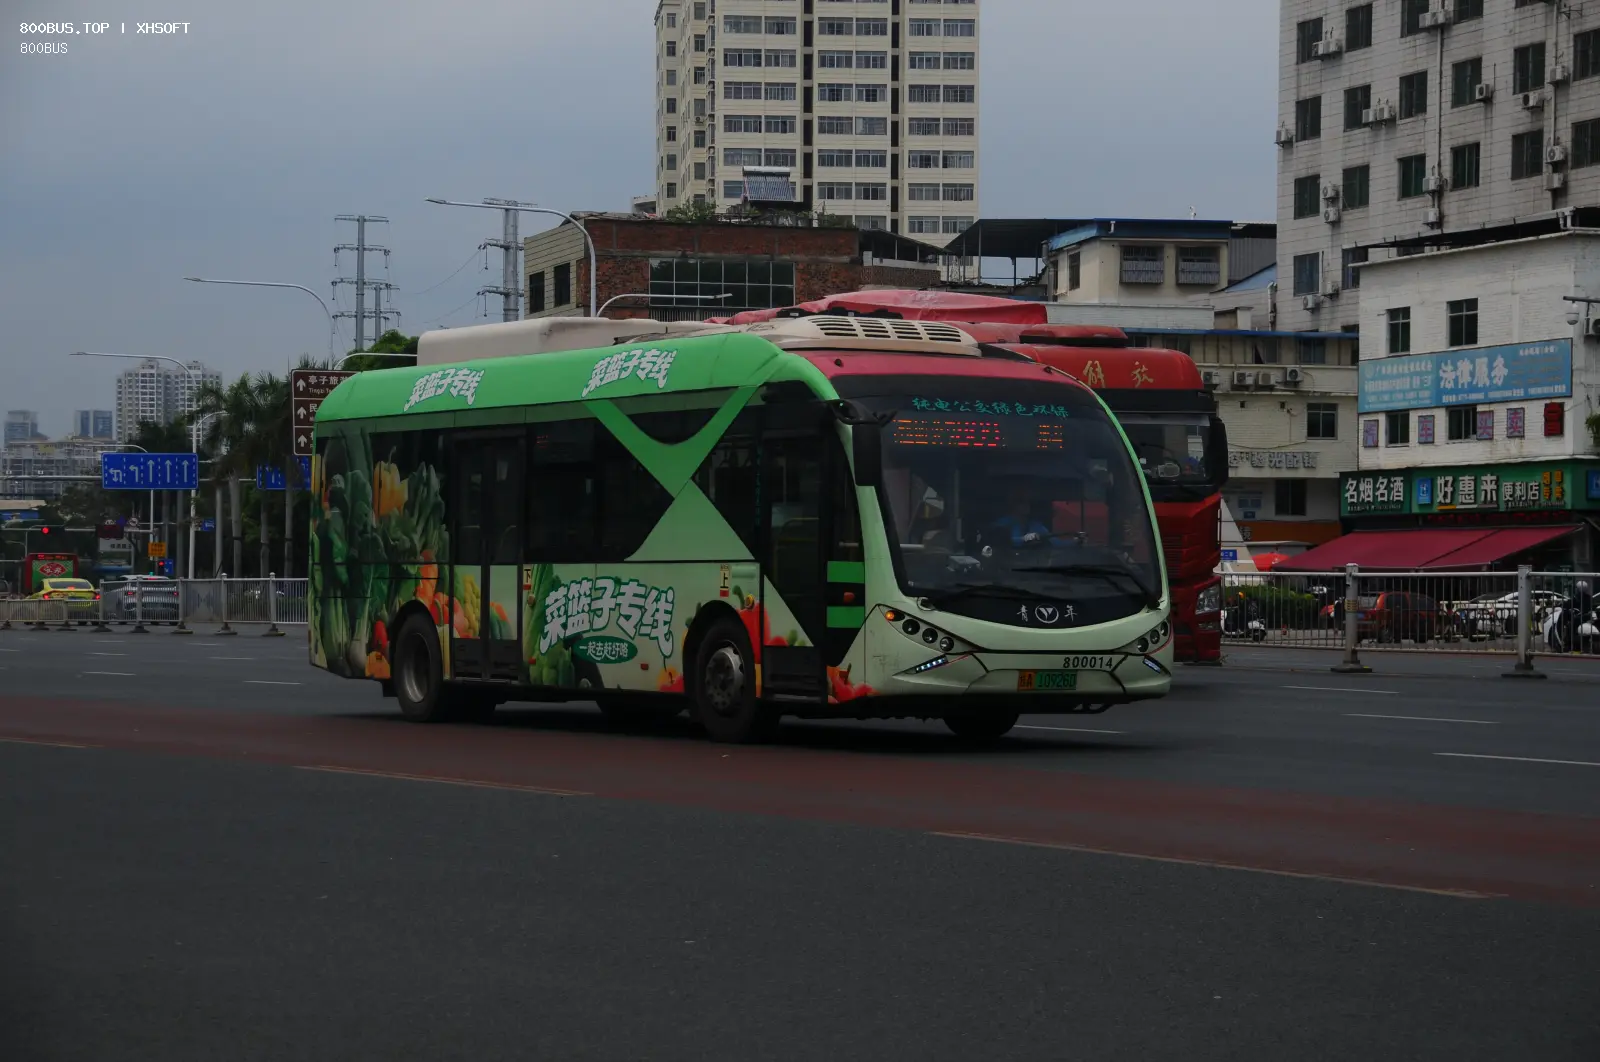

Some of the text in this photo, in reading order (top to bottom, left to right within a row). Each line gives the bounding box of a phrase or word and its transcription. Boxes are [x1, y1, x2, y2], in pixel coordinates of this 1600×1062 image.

[580, 348, 677, 398] 菜篮子专线
[1439, 354, 1508, 389] 法律服务
[403, 367, 485, 412] 菜篮子专线
[912, 397, 1069, 421] 纯电公交绿色环保
[1344, 476, 1405, 504] 名烟名酒
[1437, 474, 1498, 504] 好惠来
[1502, 481, 1540, 501] 便利店
[719, 571, 730, 589] 上
[540, 577, 673, 657] 菜篮子专线
[1062, 656, 1114, 669] 800014
